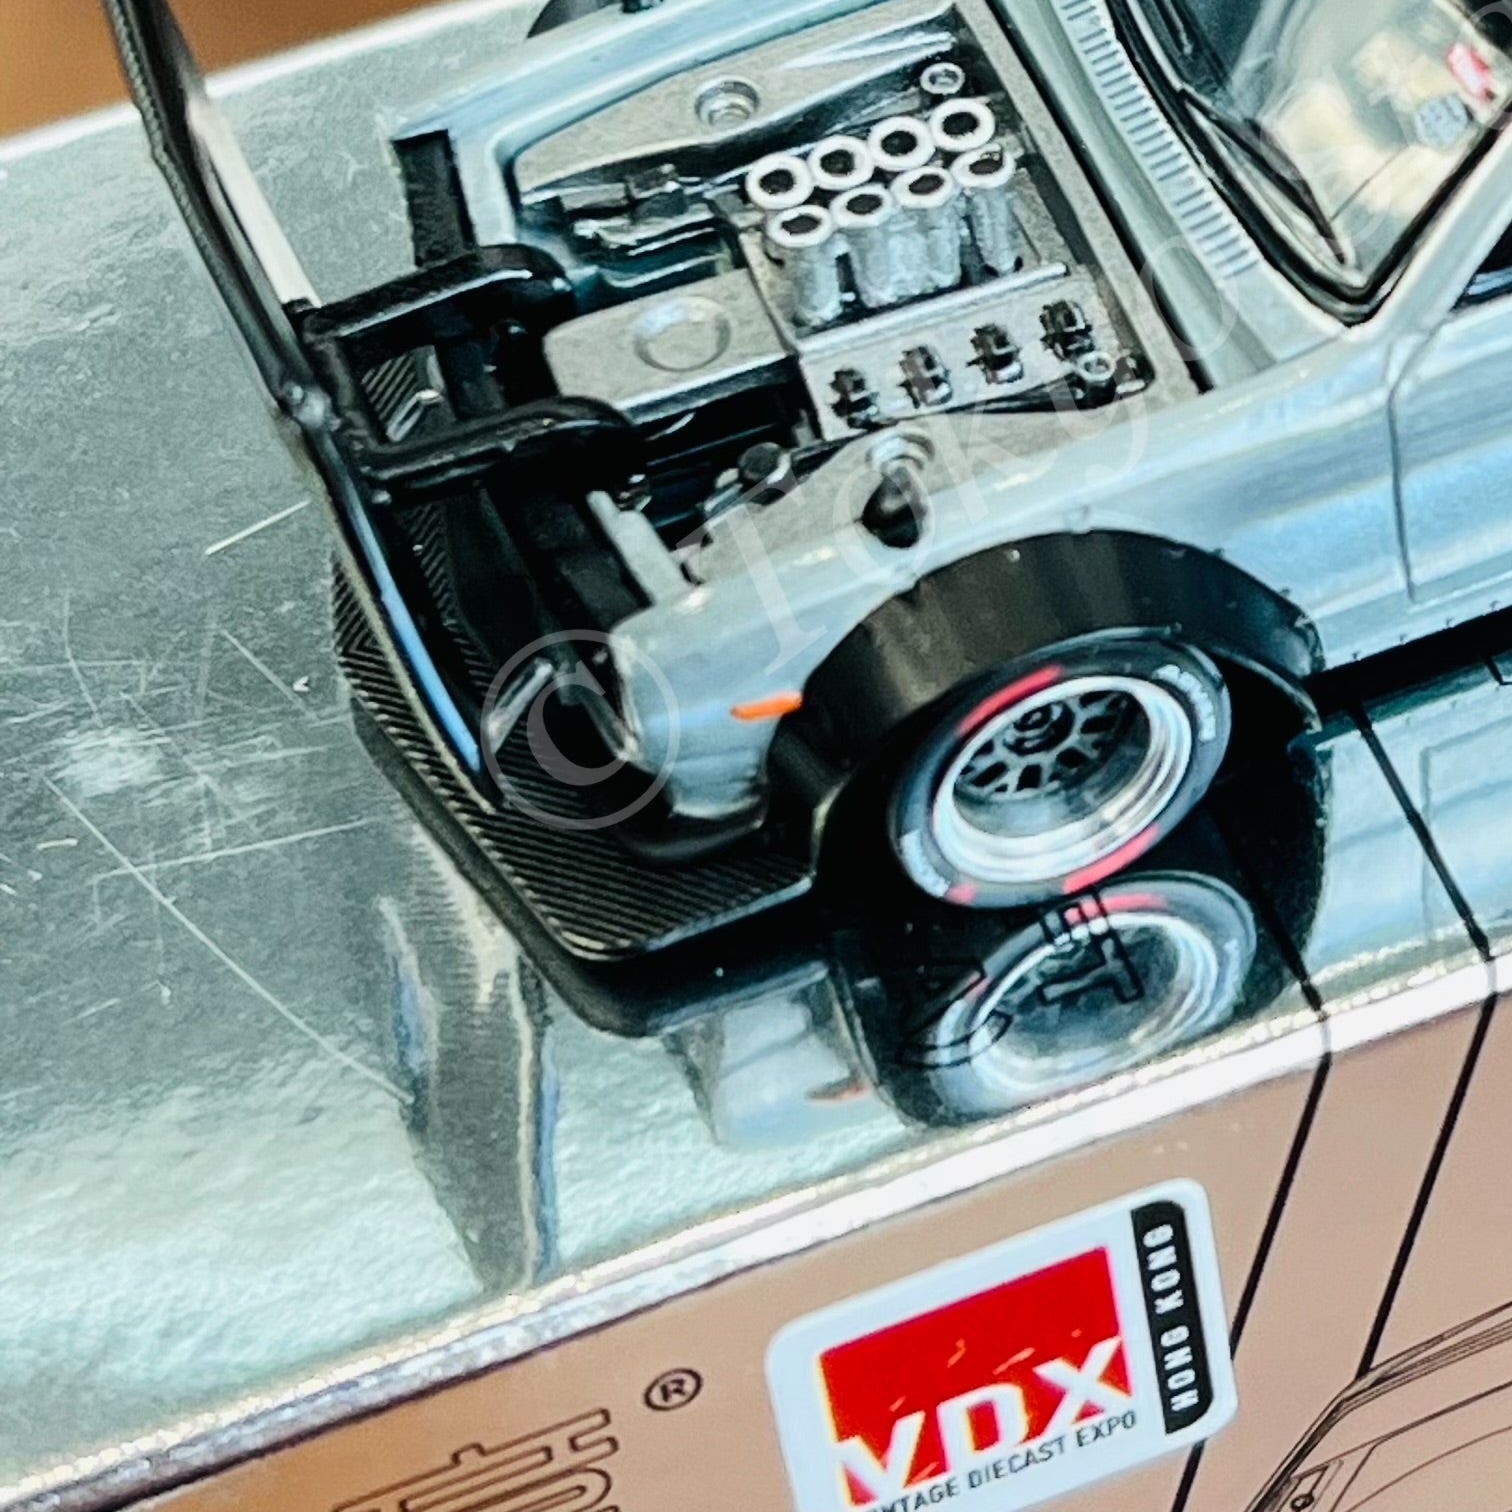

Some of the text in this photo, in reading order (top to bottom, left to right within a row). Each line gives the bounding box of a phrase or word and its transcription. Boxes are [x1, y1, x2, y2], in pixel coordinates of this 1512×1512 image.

[1143, 1223, 1199, 1413] HONG KONG
[967, 1436, 1067, 1491] DIECAST
[1075, 1409, 1138, 1449] EXPO
